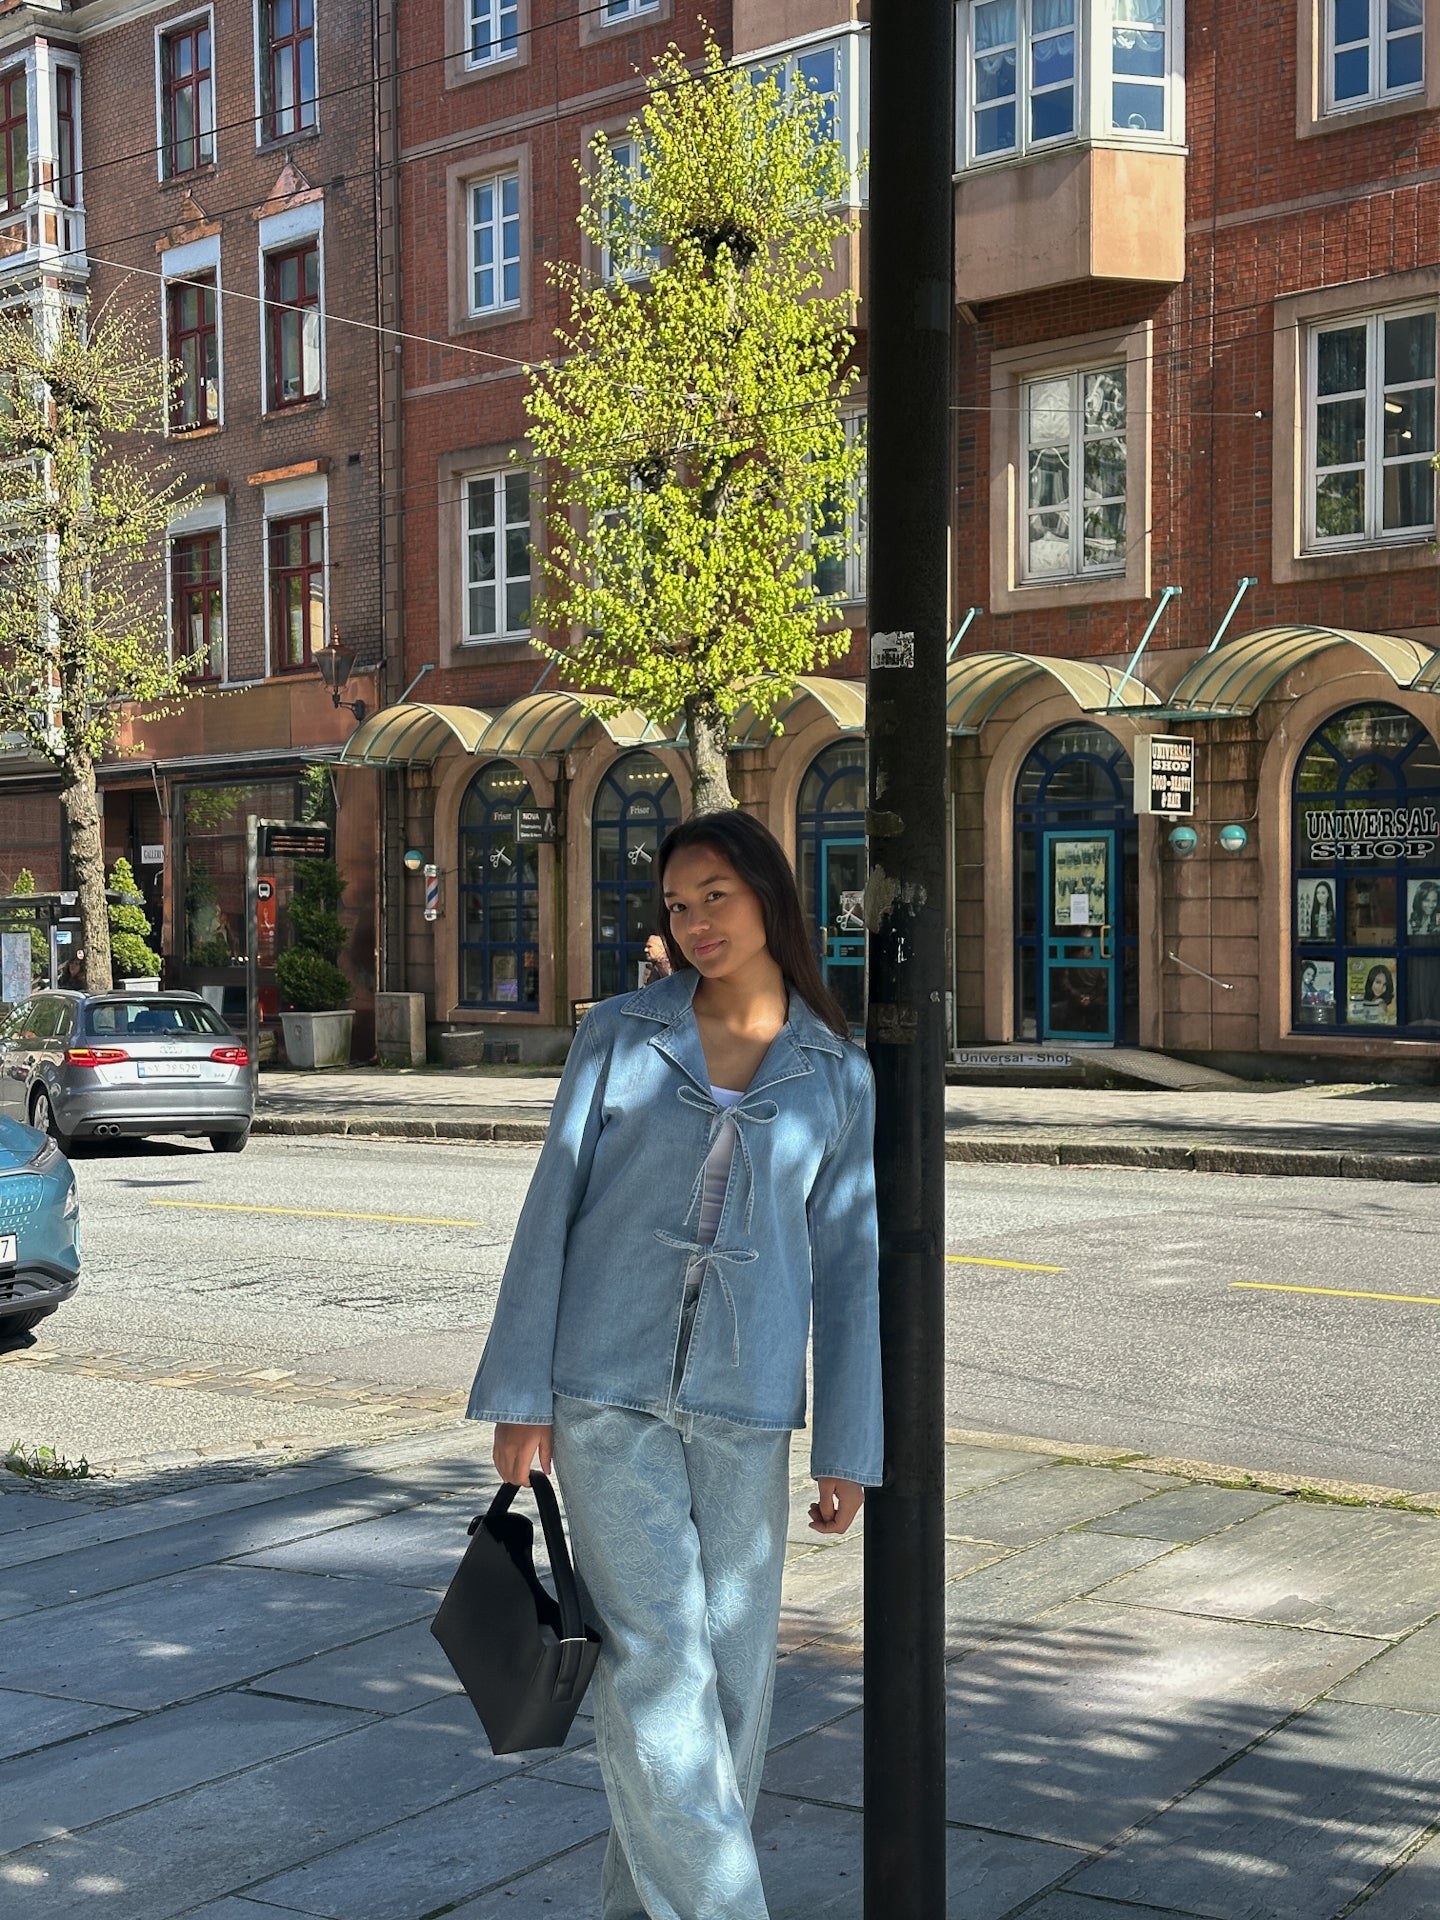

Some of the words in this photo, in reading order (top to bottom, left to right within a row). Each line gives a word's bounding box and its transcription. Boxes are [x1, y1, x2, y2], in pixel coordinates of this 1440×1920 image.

[1152, 743, 1191, 761] UNIVERSAL
[1152, 761, 1189, 771] SHOP
[1305, 807, 1440, 840] UNIVERSAL
[1310, 840, 1435, 860] SHOP
[960, 1053, 1024, 1063] Universal
[1037, 1053, 1073, 1065] Shop
